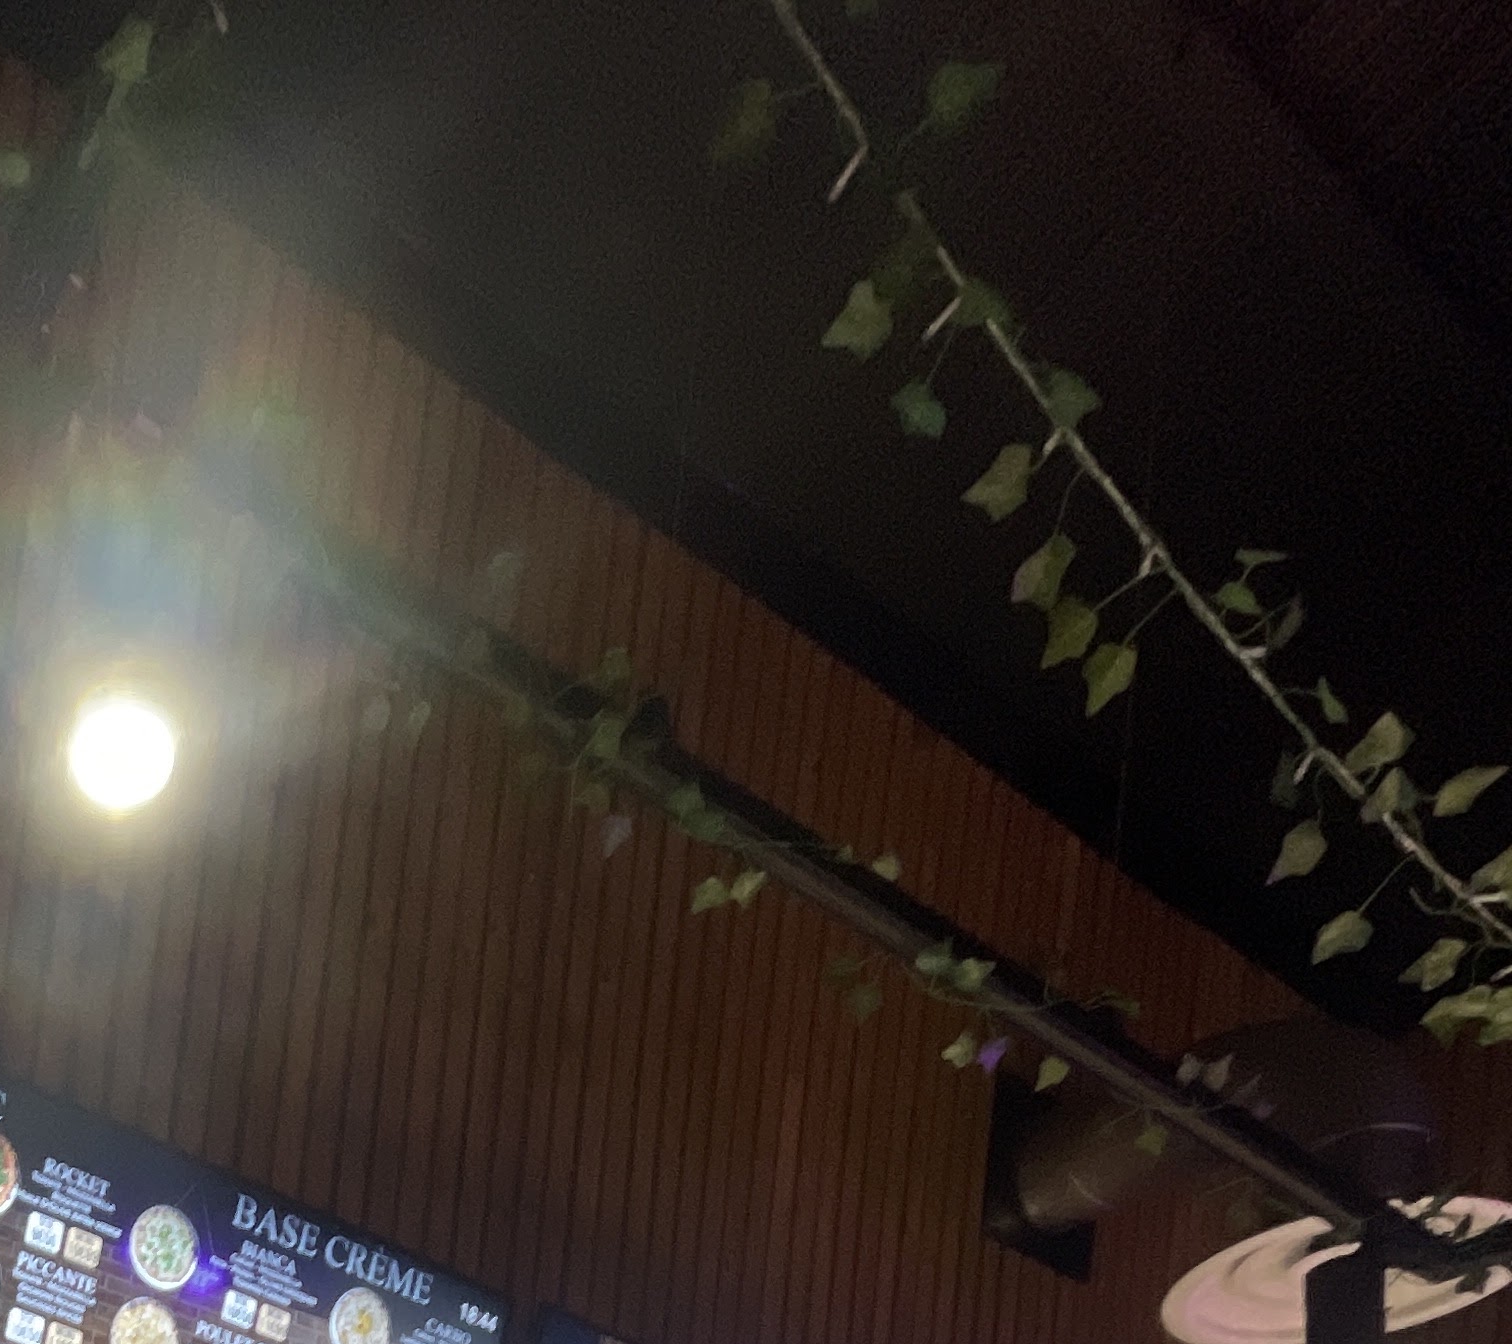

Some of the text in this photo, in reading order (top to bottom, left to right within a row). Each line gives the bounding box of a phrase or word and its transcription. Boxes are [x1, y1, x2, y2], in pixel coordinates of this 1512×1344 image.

[43, 1155, 110, 1200] ROCKET
[231, 1190, 320, 1260] BASE
[16, 1248, 98, 1296] PICCANTE
